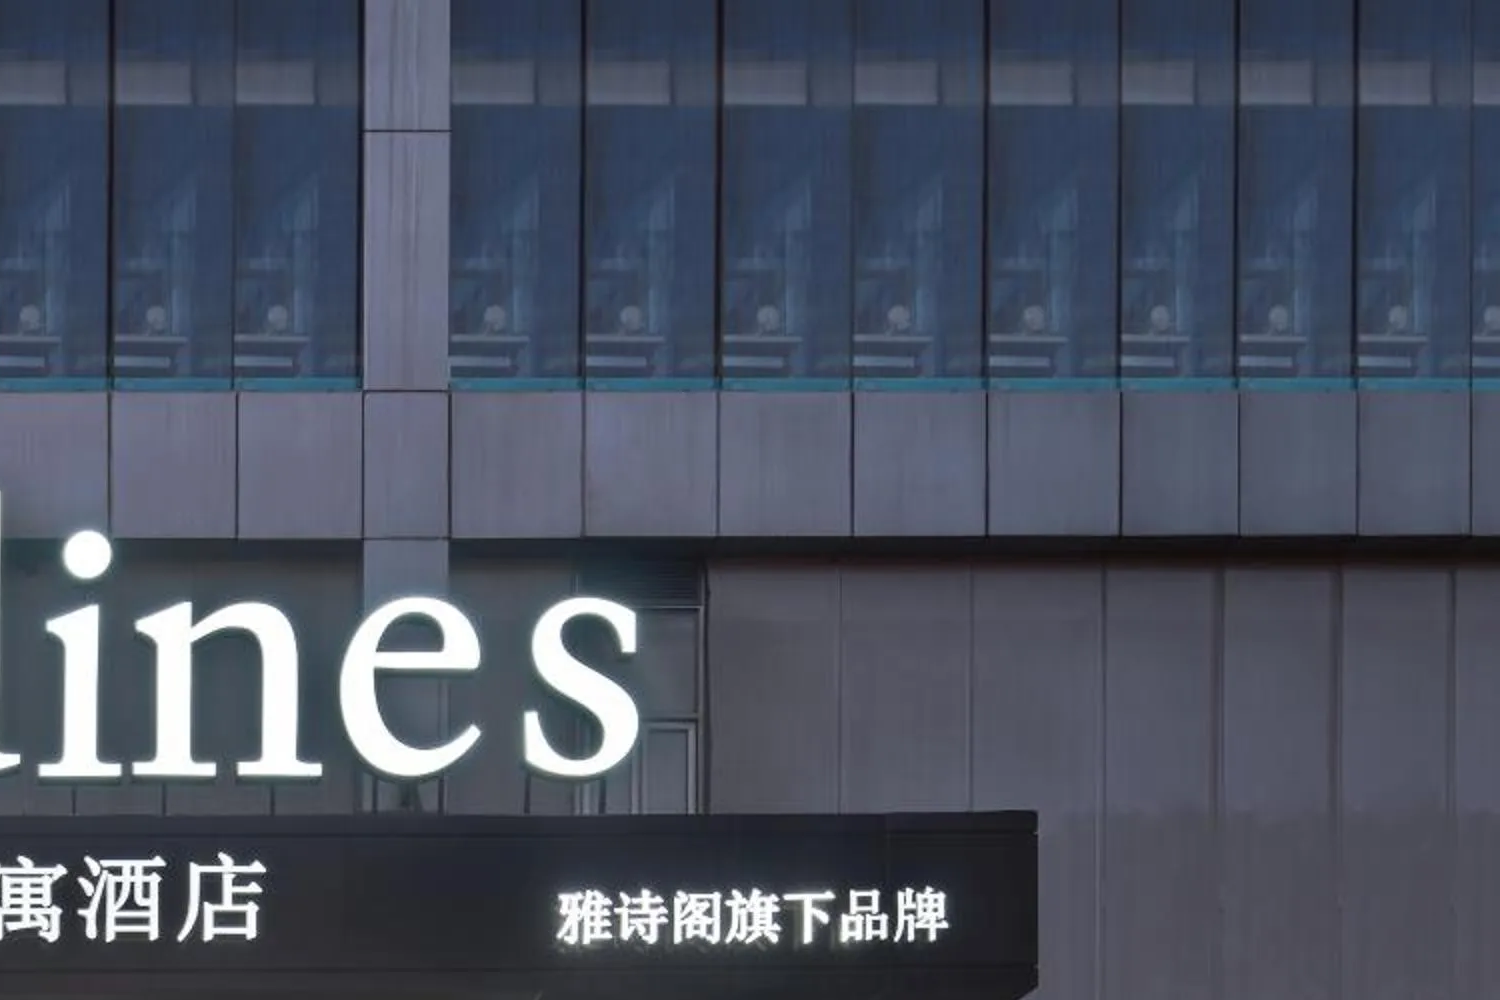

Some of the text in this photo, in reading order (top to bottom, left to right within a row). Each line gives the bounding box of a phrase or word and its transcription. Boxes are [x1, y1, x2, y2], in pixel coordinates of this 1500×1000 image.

[555, 885, 950, 946] 雅诗阁旗下品牌
